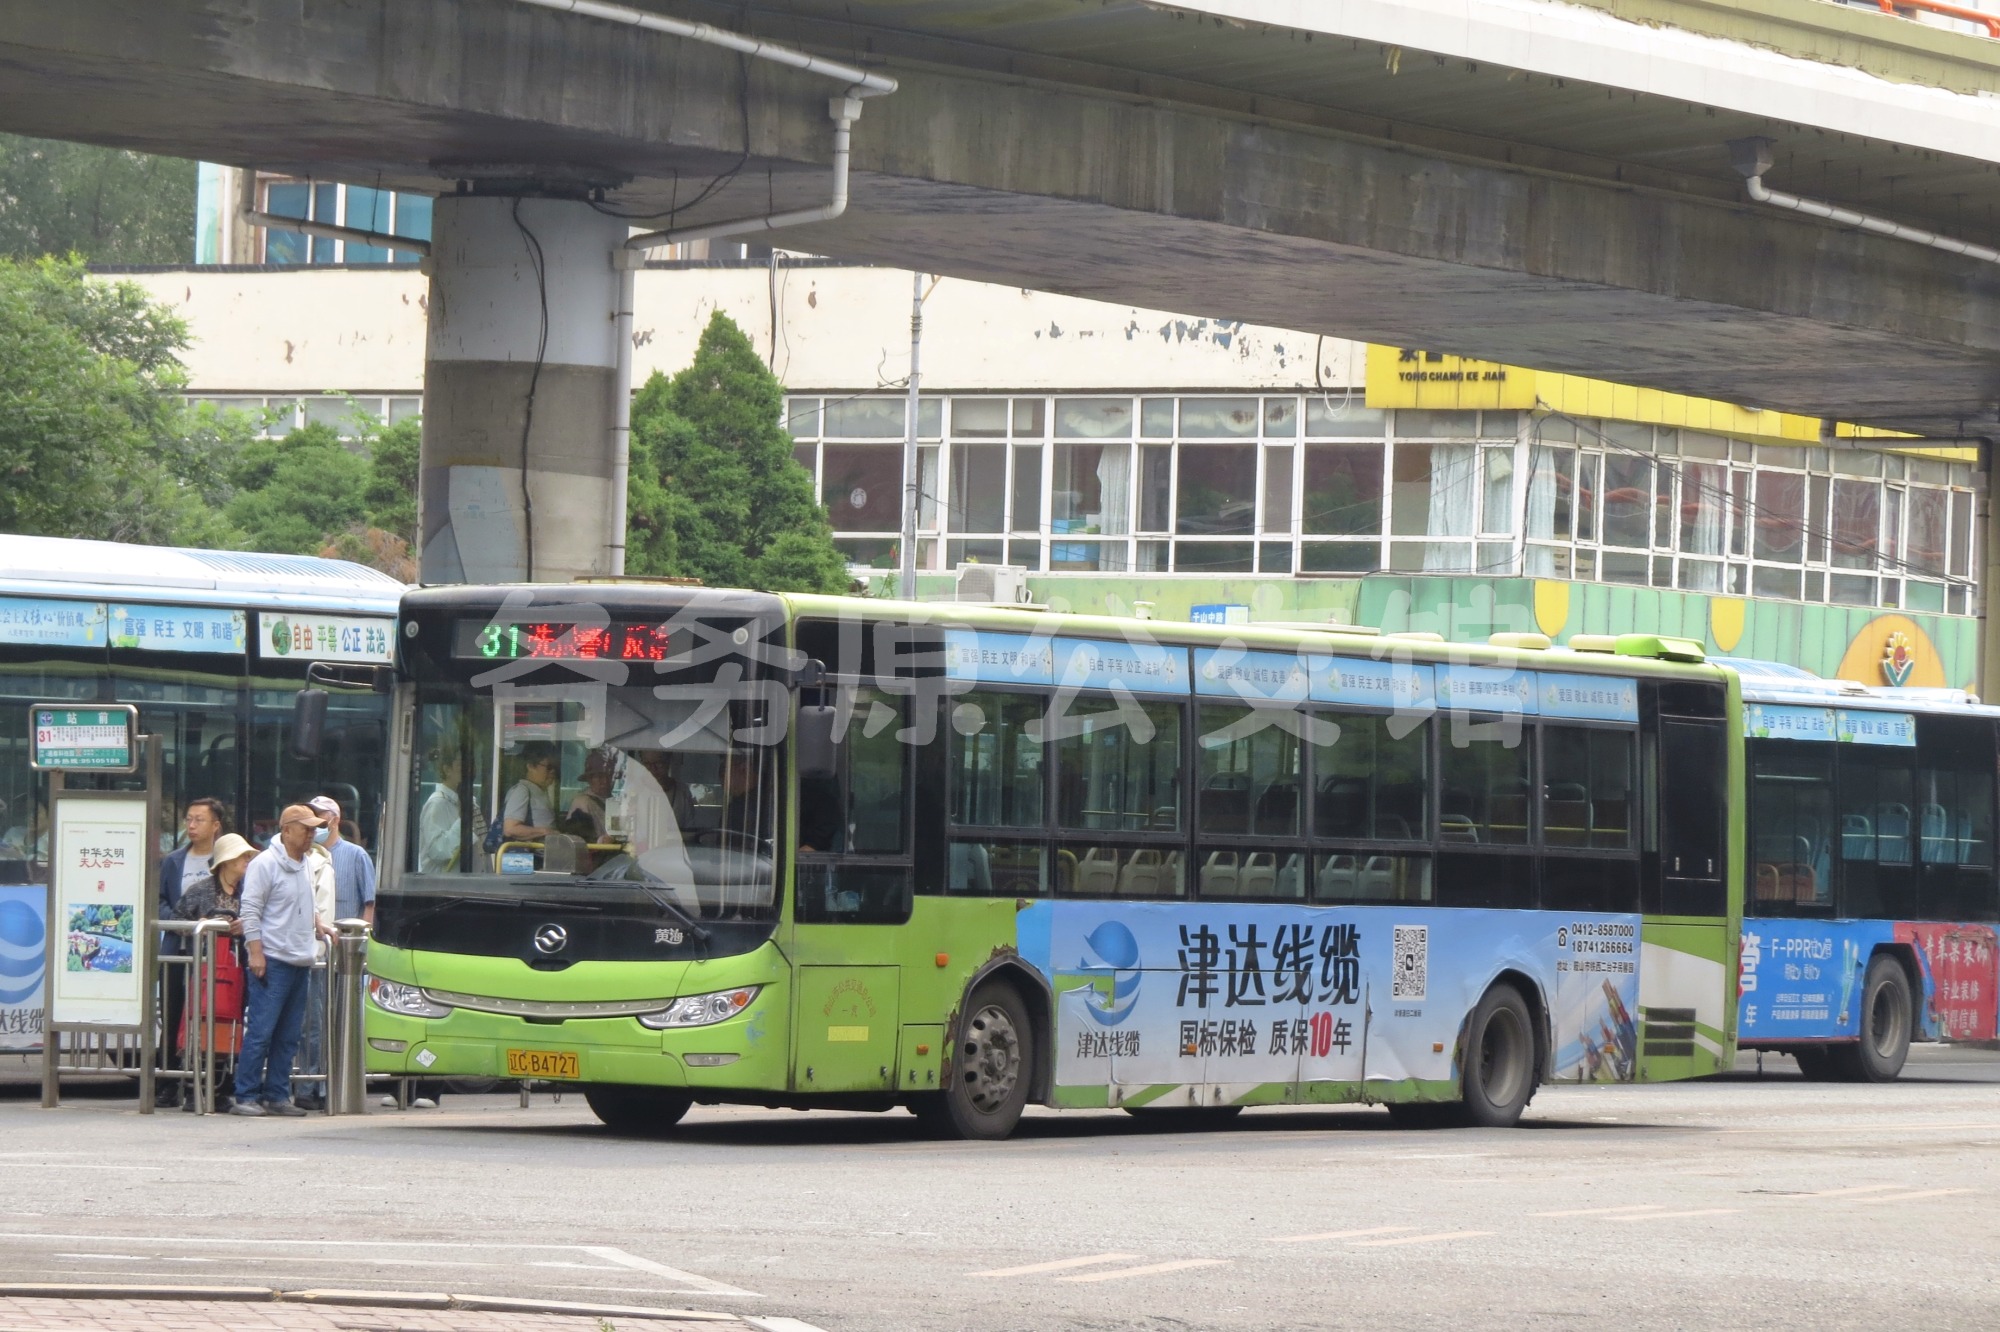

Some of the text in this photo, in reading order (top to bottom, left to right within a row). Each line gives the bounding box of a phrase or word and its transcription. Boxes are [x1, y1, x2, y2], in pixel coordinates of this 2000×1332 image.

[1398, 371, 1506, 382] YONG CHANG KE JIAN
[1192, 611, 1224, 623] 千山中路
[125, 617, 233, 640] 富强 民主 文明 和谐
[294, 623, 385, 654] 自由 平等 公正 法治
[482, 624, 519, 657] 31
[982, 650, 998, 664] 民主
[1001, 651, 1018, 665] 文明
[1089, 656, 1104, 671] 自由
[1108, 658, 1123, 673] 平等
[1126, 660, 1141, 674] 公正
[1359, 675, 1373, 689] 民主
[38, 730, 52, 742] 31
[80, 848, 125, 858] 中华文明
[79, 858, 125, 868] 天人合一
[654, 927, 684, 944] 黄海
[1571, 923, 1634, 937] 0412-8587000
[1572, 940, 1633, 953] 18741266664
[1176, 923, 1361, 1008] 津达线缆
[1940, 979, 1980, 1001] 专业装修
[1179, 1011, 1351, 1058] 国标保检 质保10年
[1077, 1031, 1141, 1058] 津达线缆
